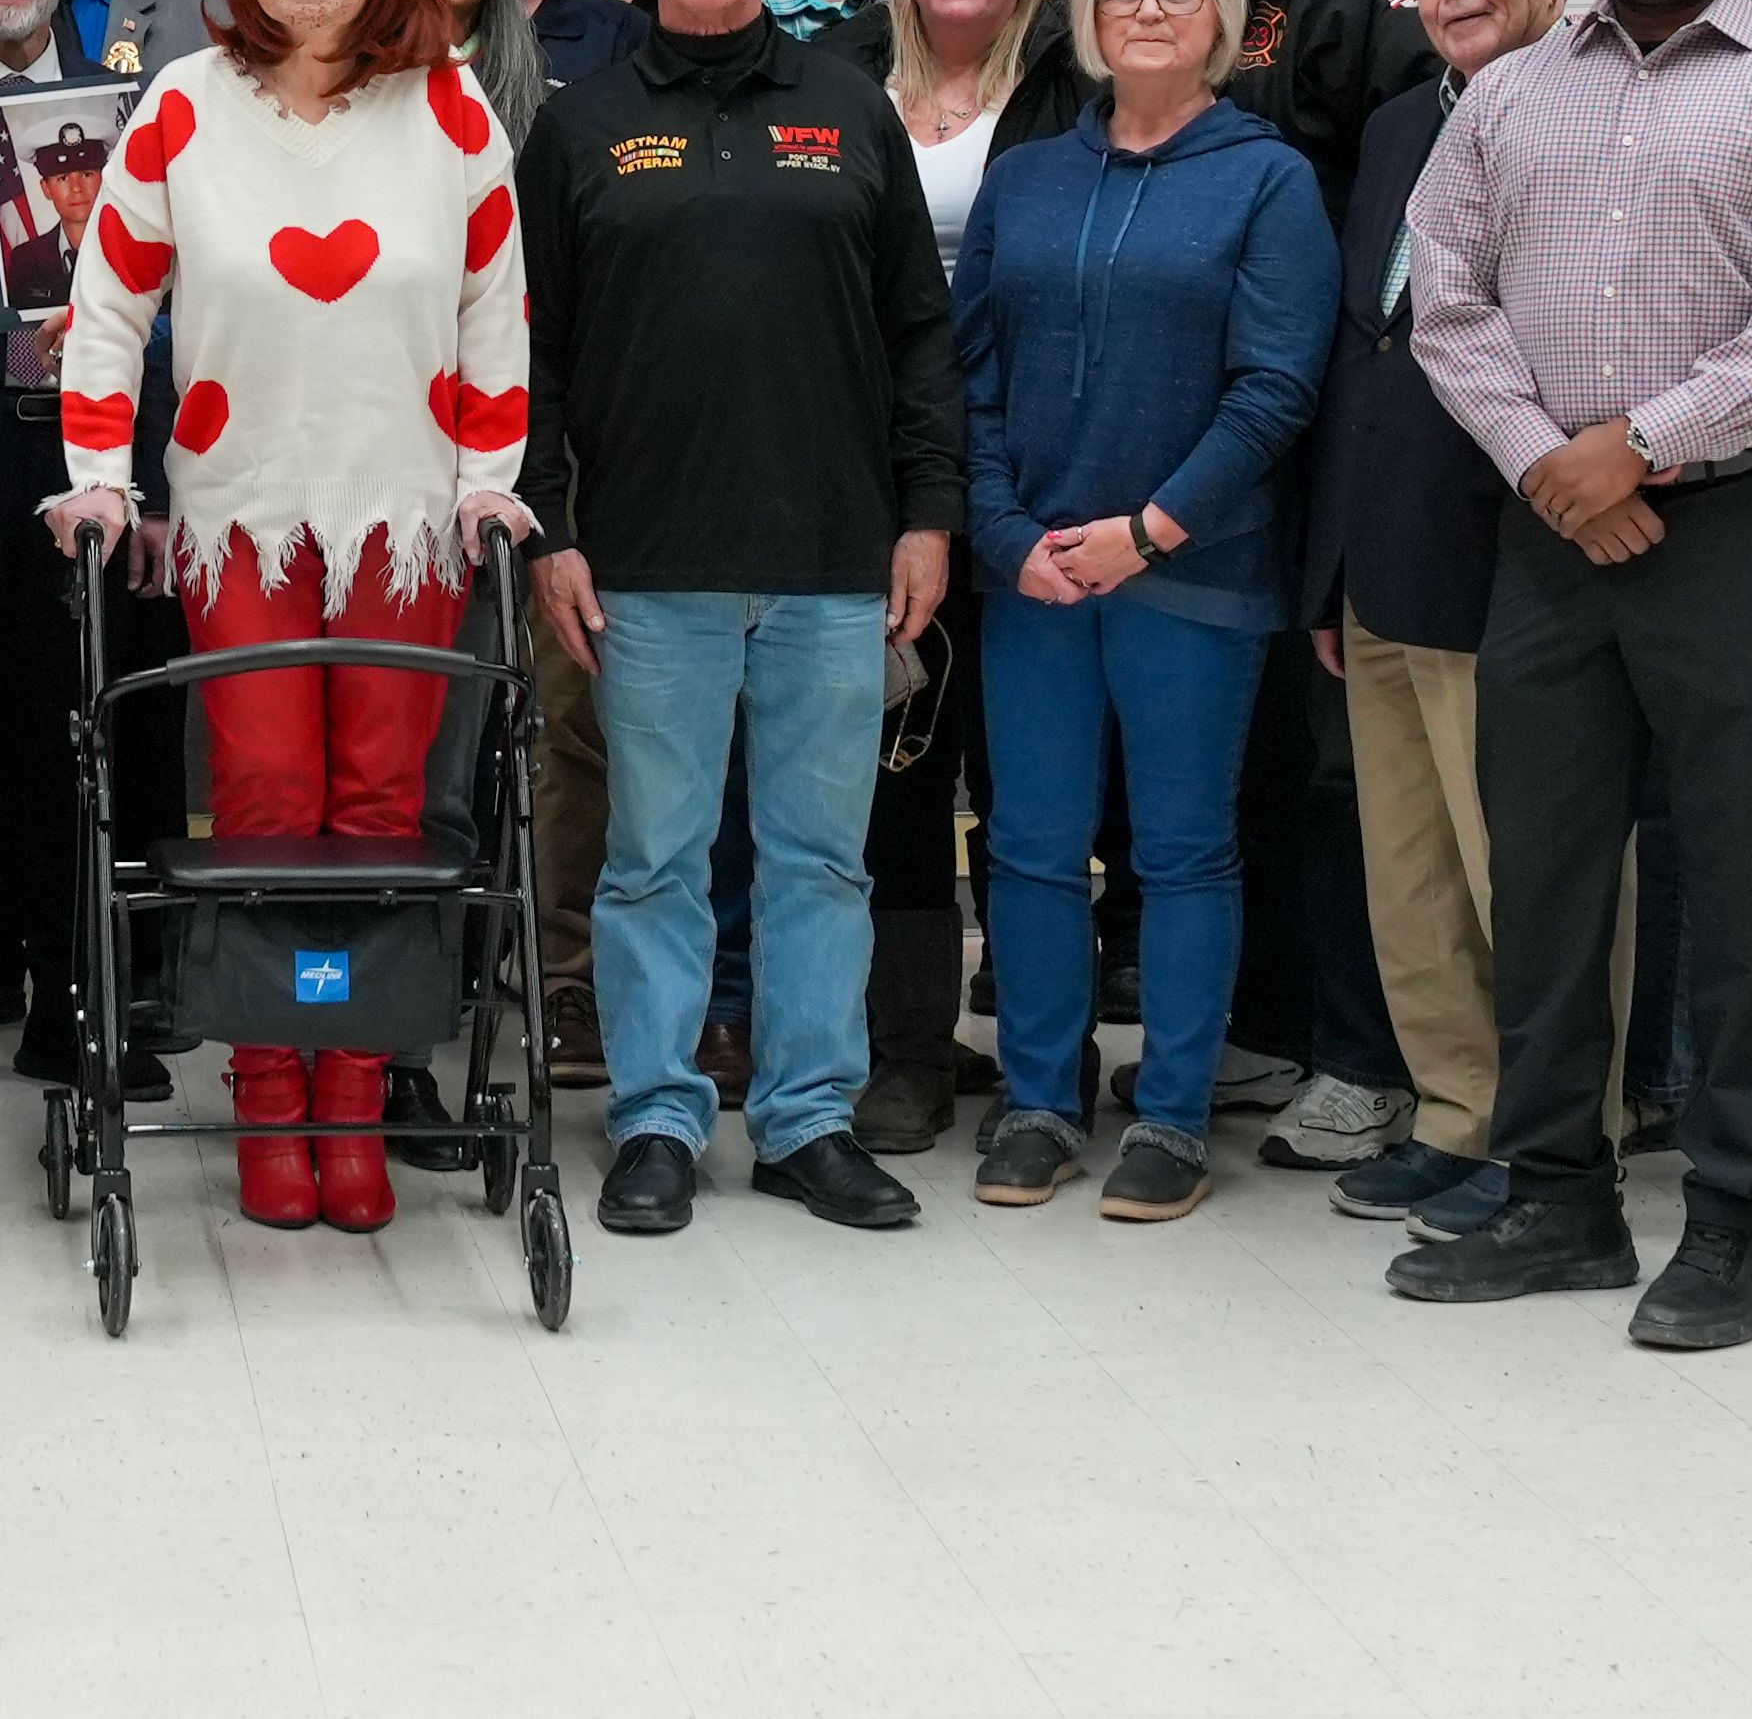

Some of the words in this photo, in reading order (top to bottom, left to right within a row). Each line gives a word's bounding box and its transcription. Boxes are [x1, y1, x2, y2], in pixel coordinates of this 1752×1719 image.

[779, 126, 840, 146] VFW
[609, 135, 688, 158] VIETNAM
[617, 157, 683, 175] VETERAN
[788, 154, 809, 163] POST
